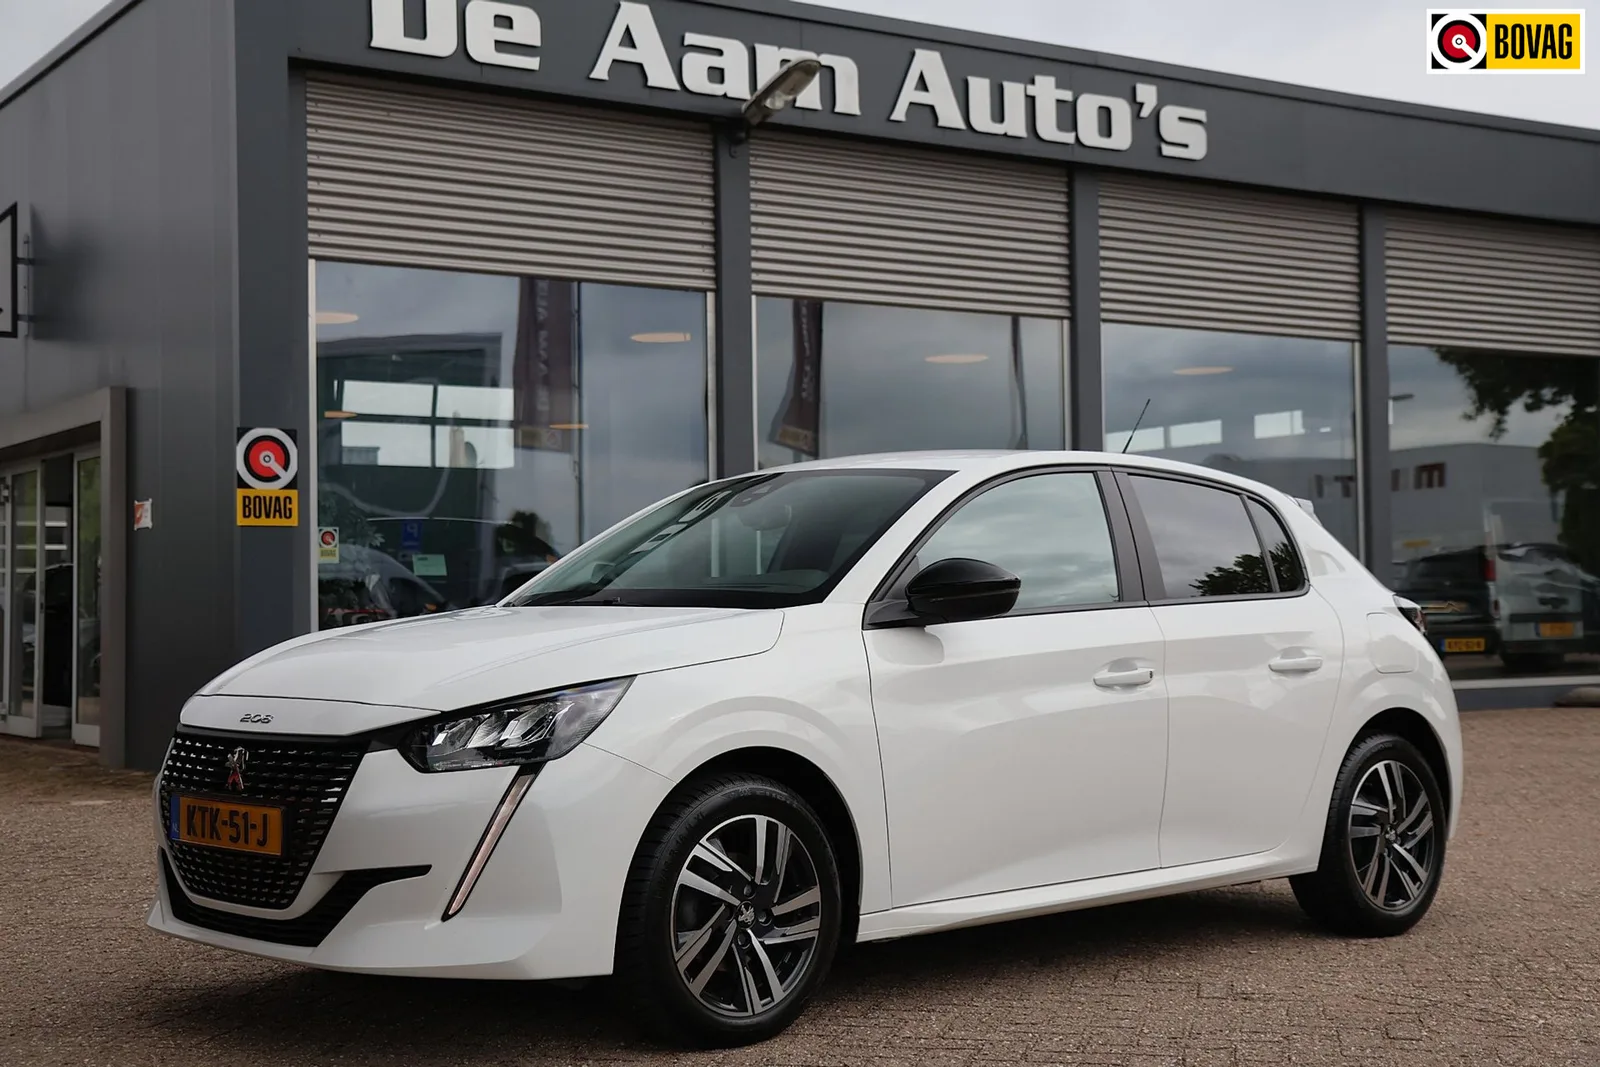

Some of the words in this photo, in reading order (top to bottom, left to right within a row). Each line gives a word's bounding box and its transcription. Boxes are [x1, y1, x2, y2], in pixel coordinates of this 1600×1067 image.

[370, 0, 542, 71] De
[589, 1, 861, 116] Aam
[890, 48, 1208, 161] Auto's
[242, 495, 293, 520] BOVAG
[186, 804, 269, 847] KTK-51-J
